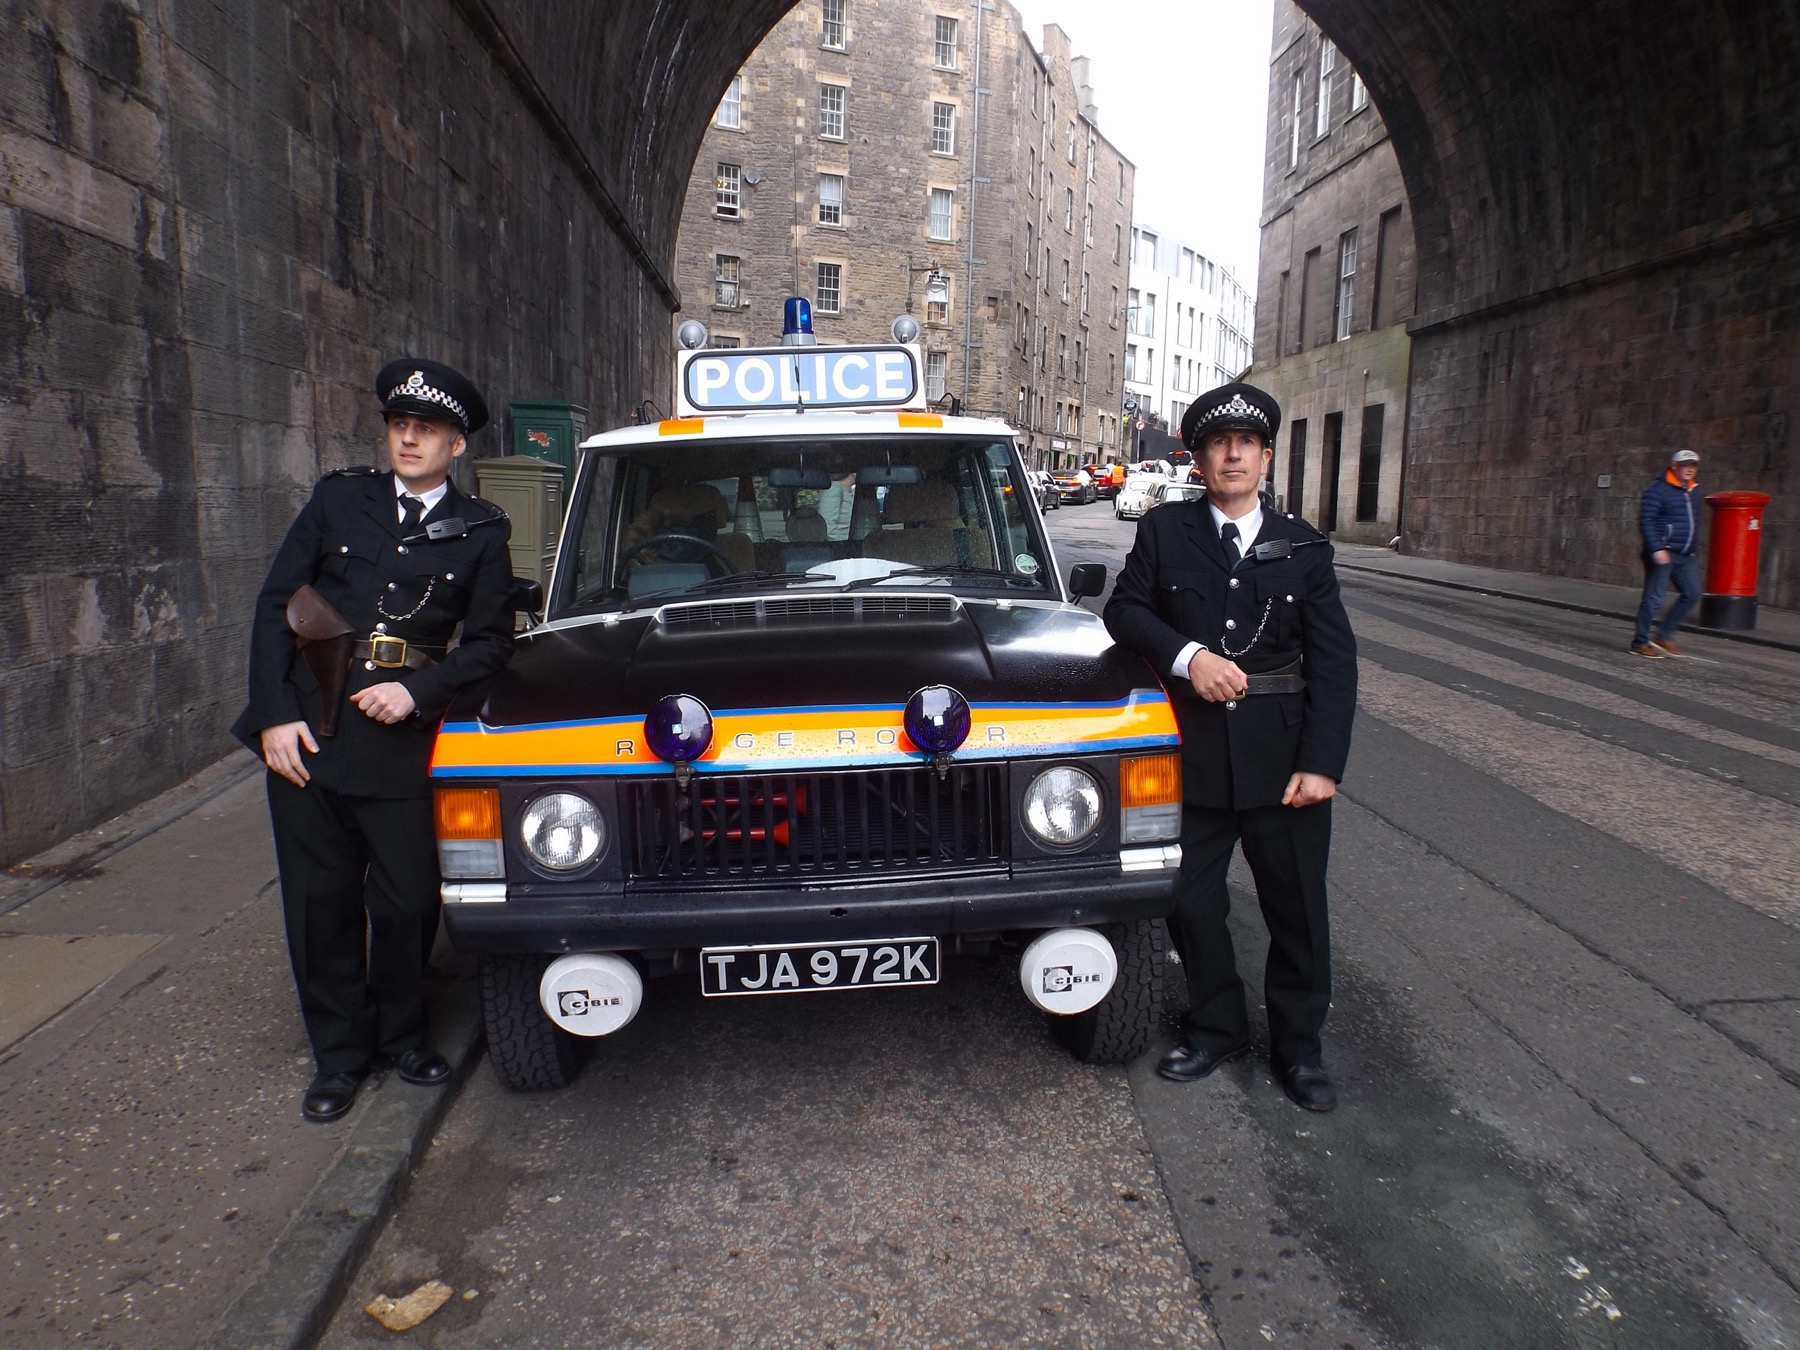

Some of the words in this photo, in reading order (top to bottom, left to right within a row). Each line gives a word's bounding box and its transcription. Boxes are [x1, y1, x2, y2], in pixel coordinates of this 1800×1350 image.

[696, 353, 907, 404] POLICE
[615, 731, 795, 756] RGE
[836, 725, 1007, 747] ROR
[707, 952, 800, 991] TJA
[809, 944, 931, 985] 972K
